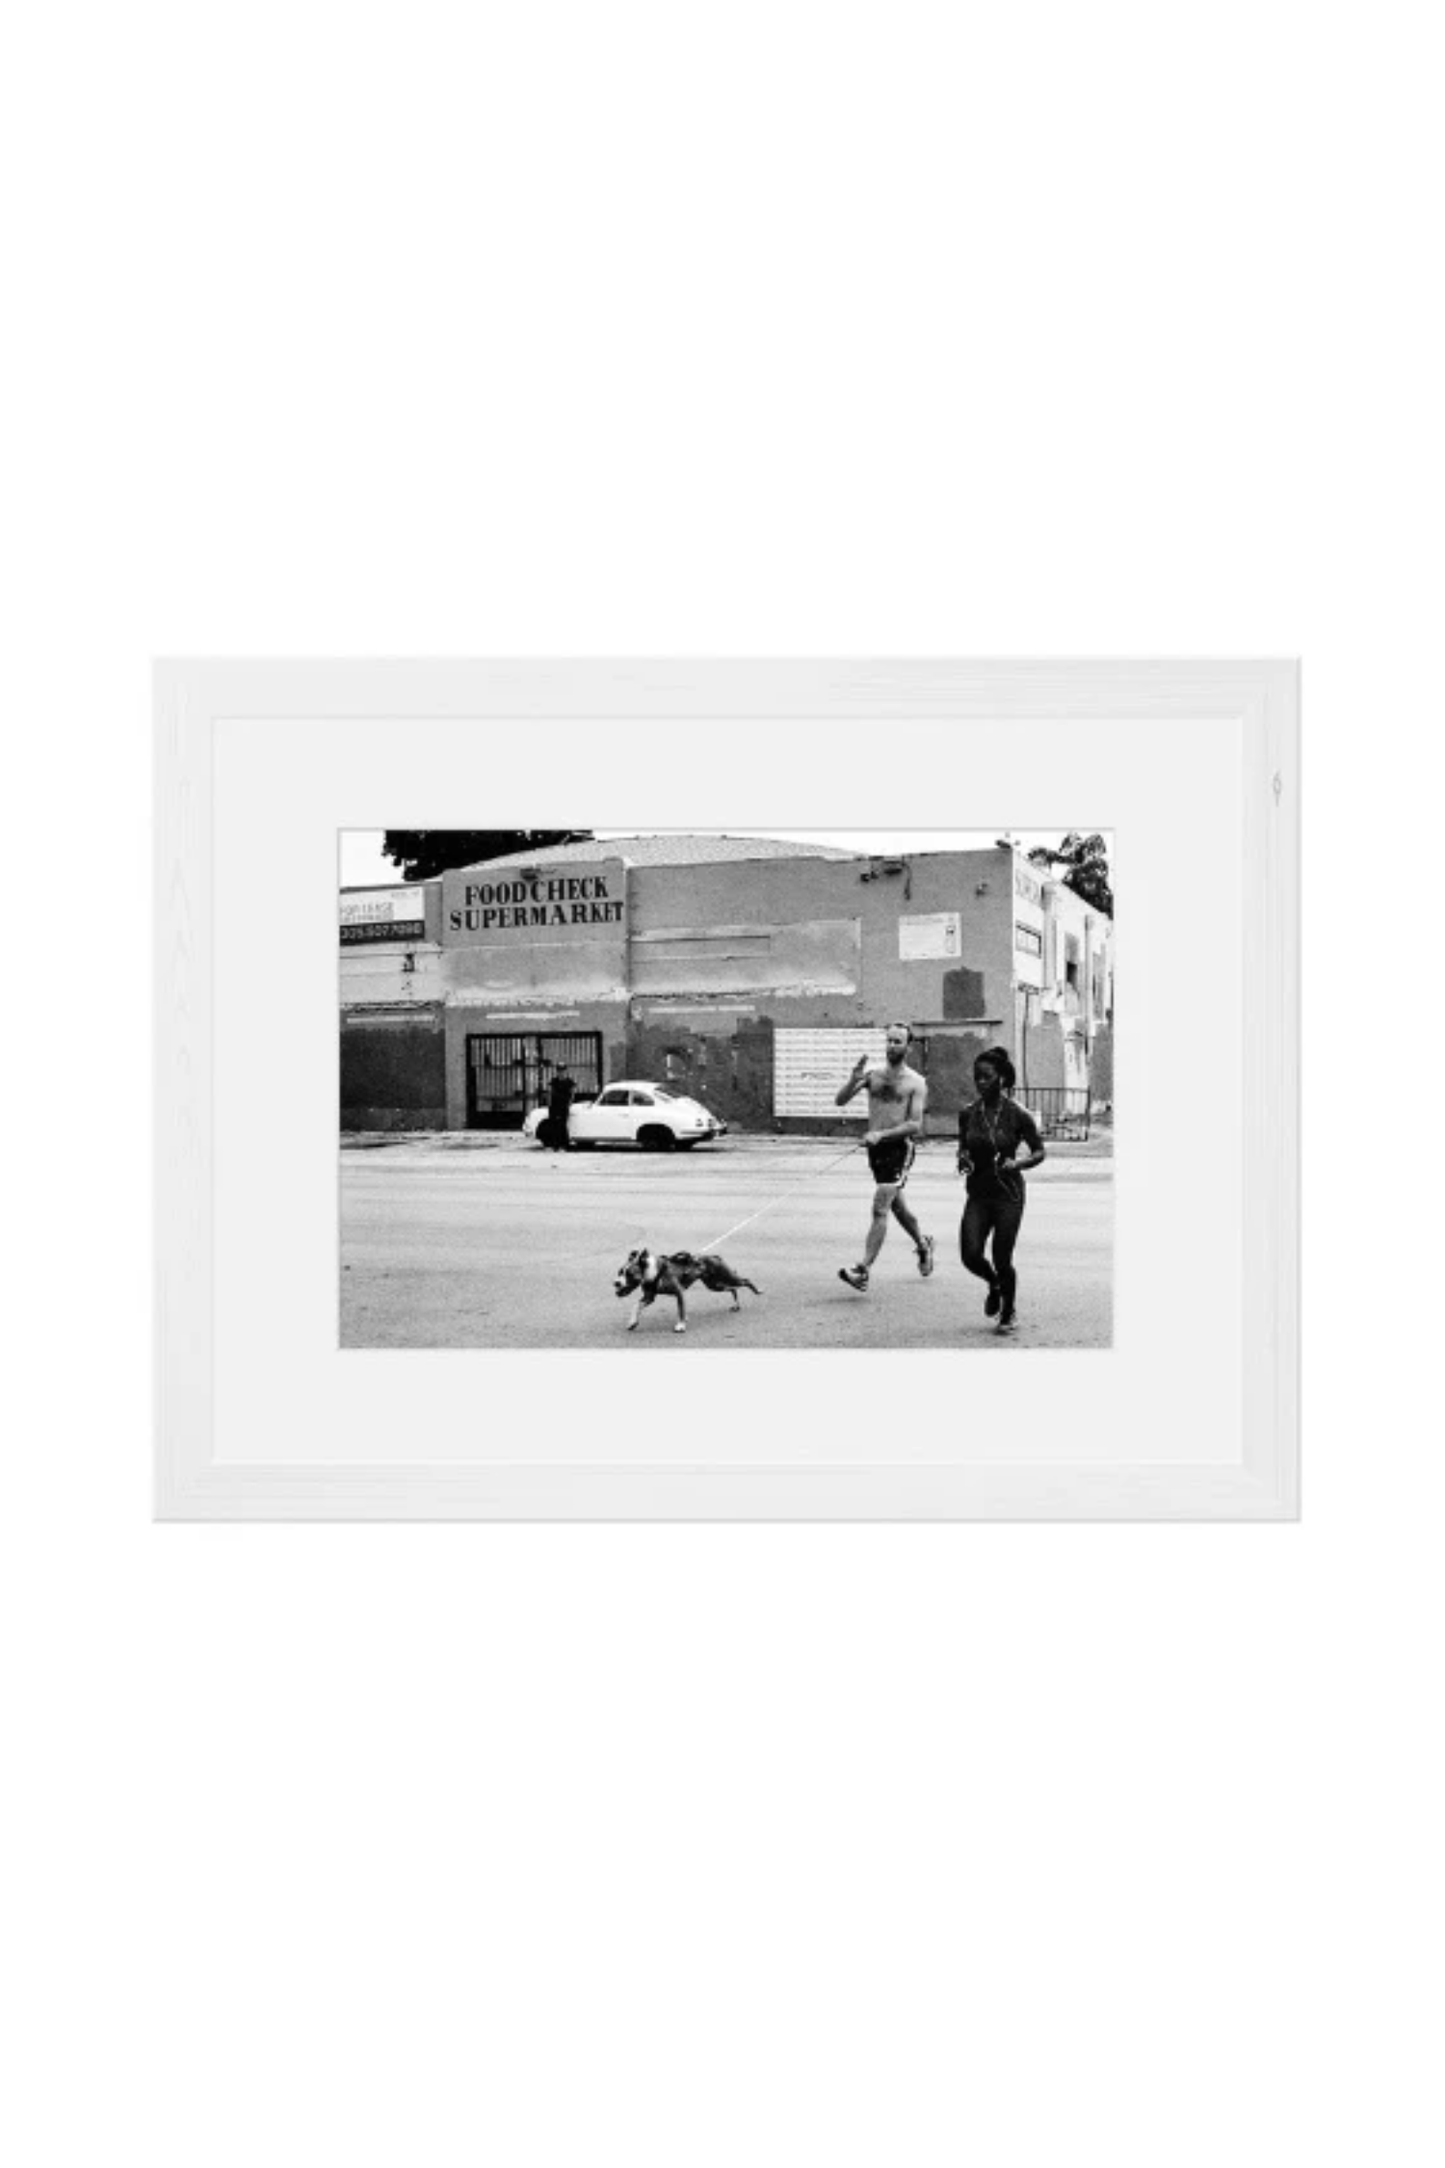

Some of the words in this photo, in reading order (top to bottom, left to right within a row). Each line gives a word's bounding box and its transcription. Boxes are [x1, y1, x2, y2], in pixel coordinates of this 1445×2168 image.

[465, 880, 526, 906] FOOD
[530, 876, 609, 903] CHECK
[450, 902, 624, 931] SUPERMARKET
